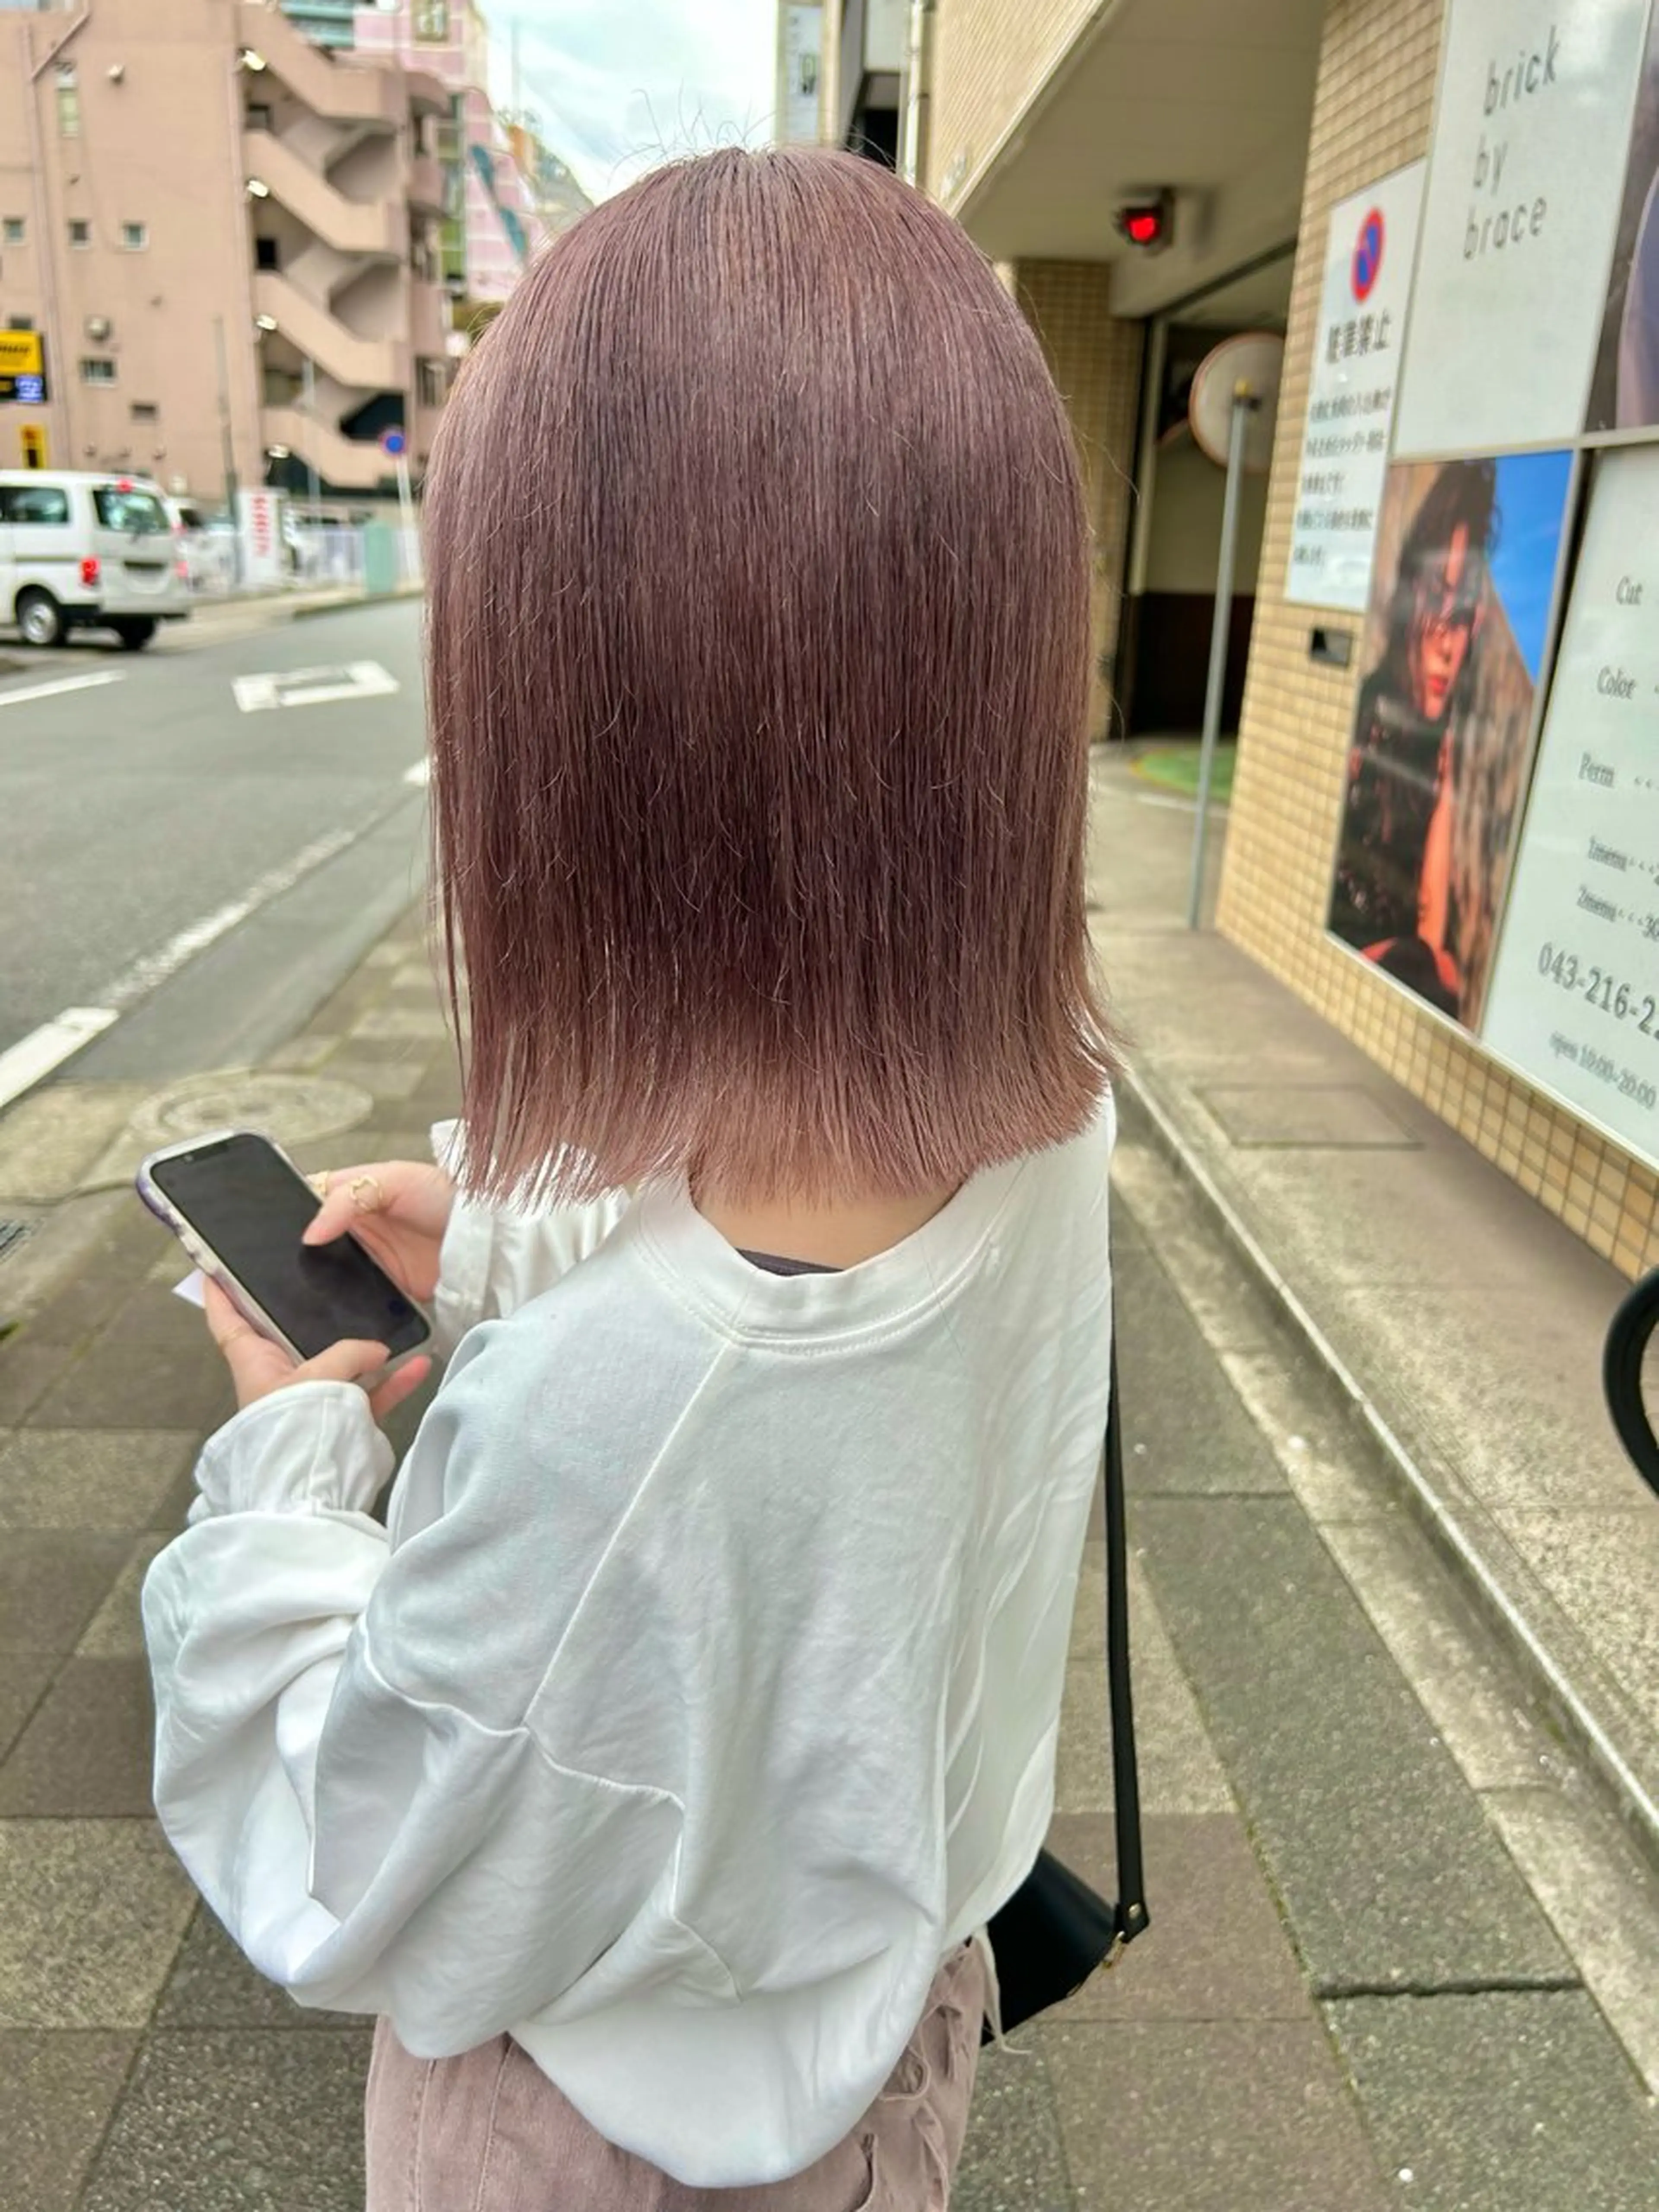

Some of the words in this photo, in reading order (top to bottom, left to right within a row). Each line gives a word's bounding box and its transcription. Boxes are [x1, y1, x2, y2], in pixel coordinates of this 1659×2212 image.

[1484, 25, 1560, 116] brick
[1474, 134, 1508, 196] by
[1538, 942, 1659, 1040] 043-216-2
